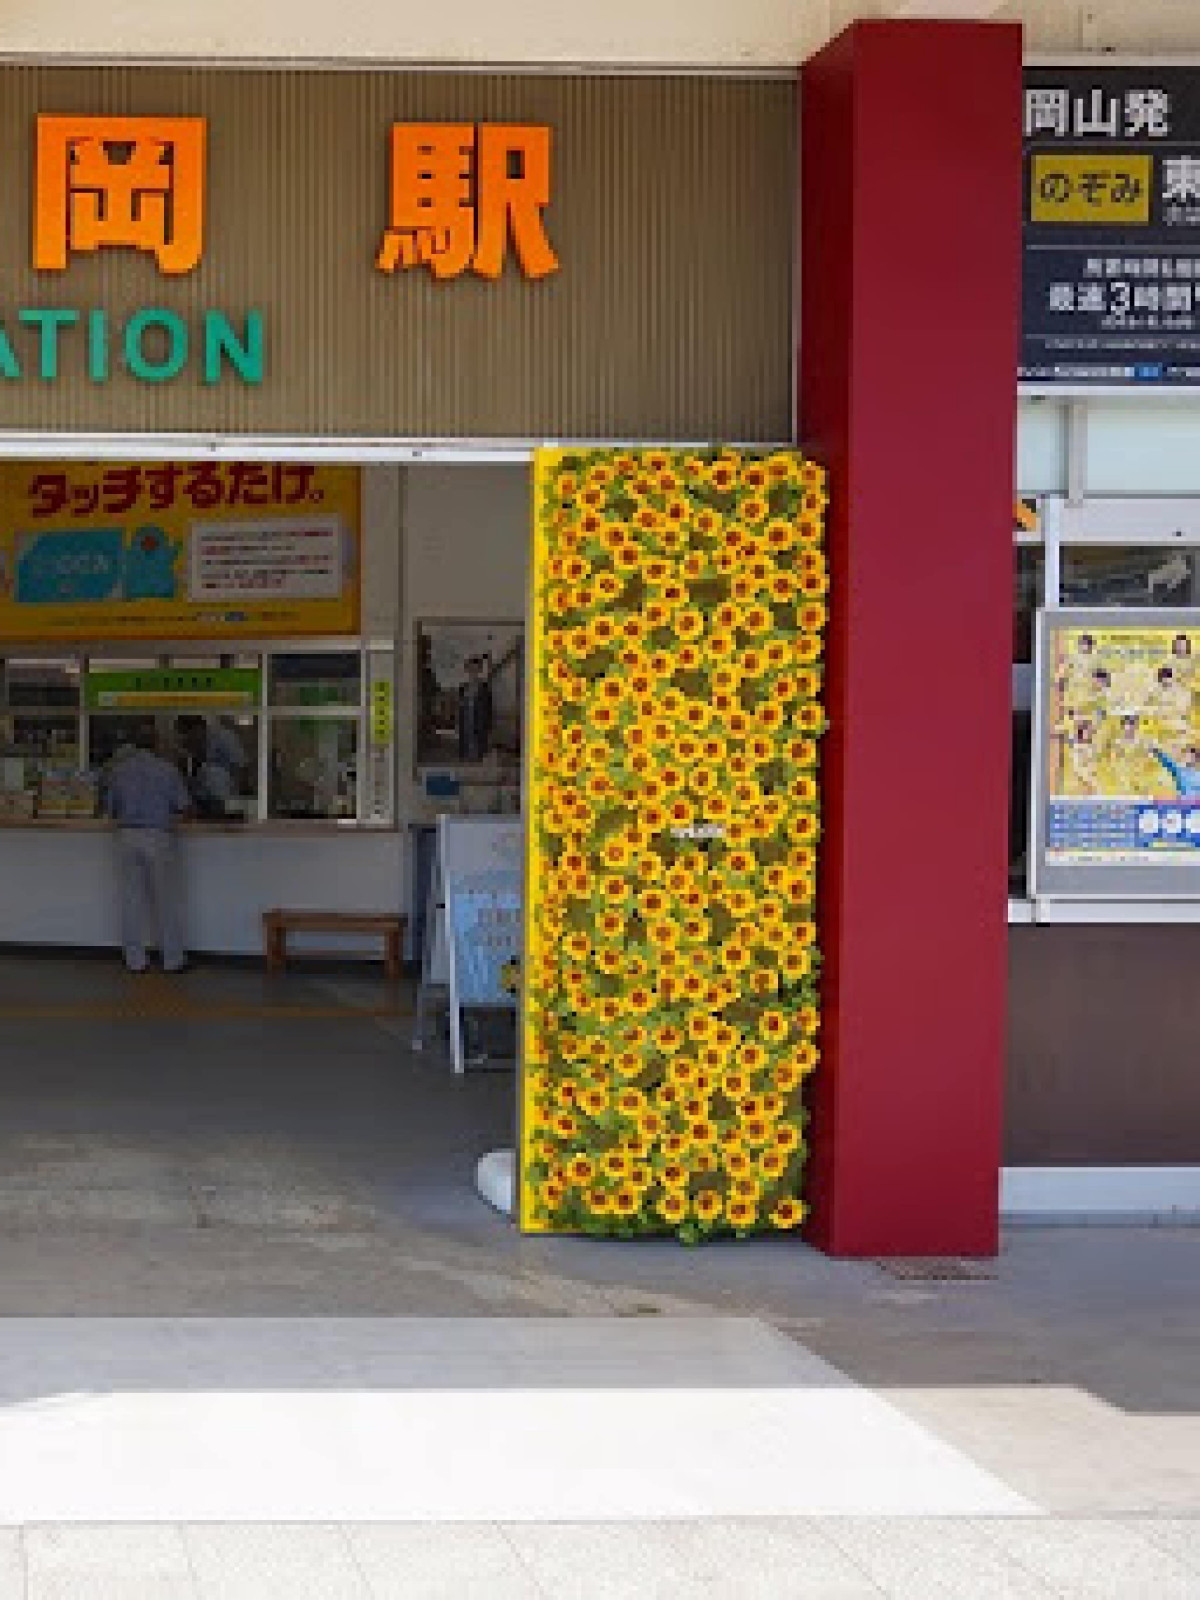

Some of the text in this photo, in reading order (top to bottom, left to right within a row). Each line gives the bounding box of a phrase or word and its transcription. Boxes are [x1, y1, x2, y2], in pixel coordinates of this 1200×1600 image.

[1024, 88, 1169, 137] 岡山発
[1039, 172, 1143, 206] のぞみ
